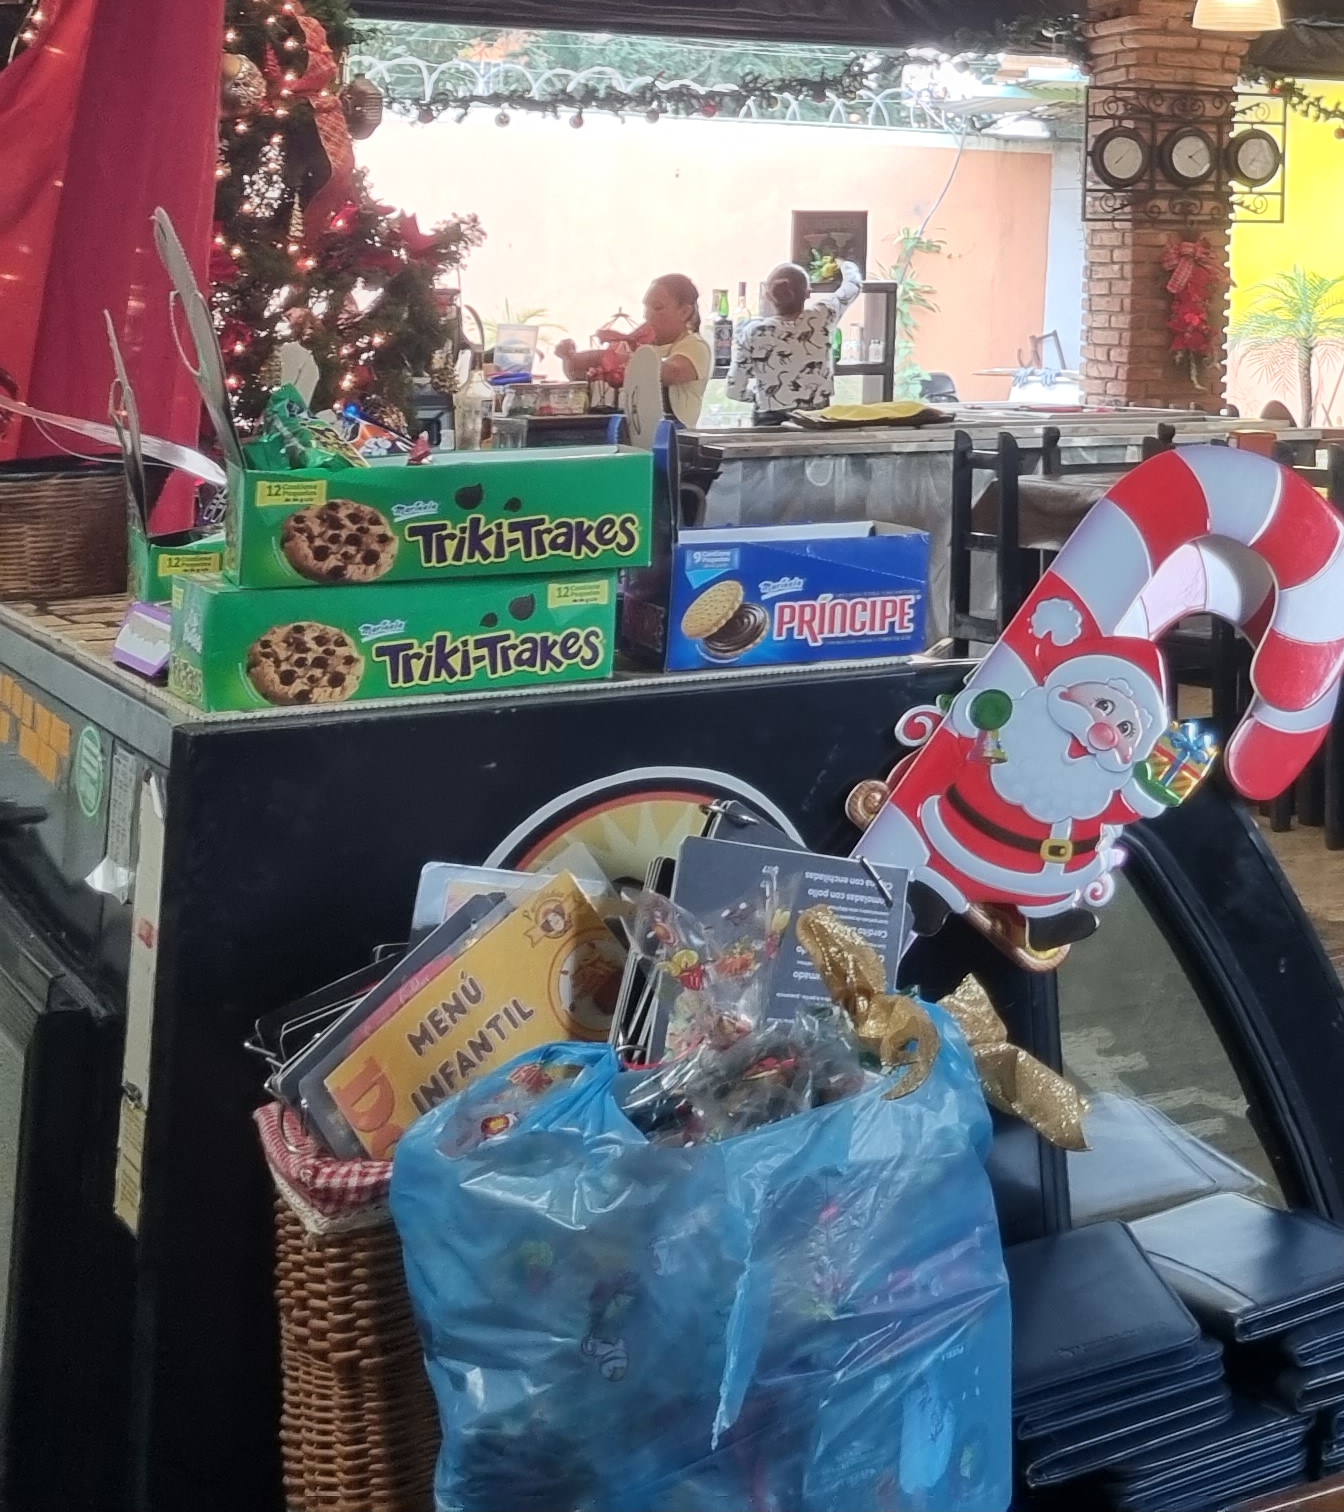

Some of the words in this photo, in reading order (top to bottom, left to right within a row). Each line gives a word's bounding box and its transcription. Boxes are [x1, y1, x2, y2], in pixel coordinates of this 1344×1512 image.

[266, 485, 282, 497] 12
[406, 515, 638, 566] Triki-Trakes
[166, 556, 181, 568] 12
[556, 585, 570, 599] 12
[773, 593, 915, 647] PRÍNCIPE
[373, 628, 603, 687] Triki-Trakes
[804, 871, 849, 886] enchiladas
[807, 888, 830, 899] pollo
[846, 893, 886, 905] nmoladas
[406, 970, 482, 1057] MENÚ
[410, 998, 535, 1116] INFANTIL
